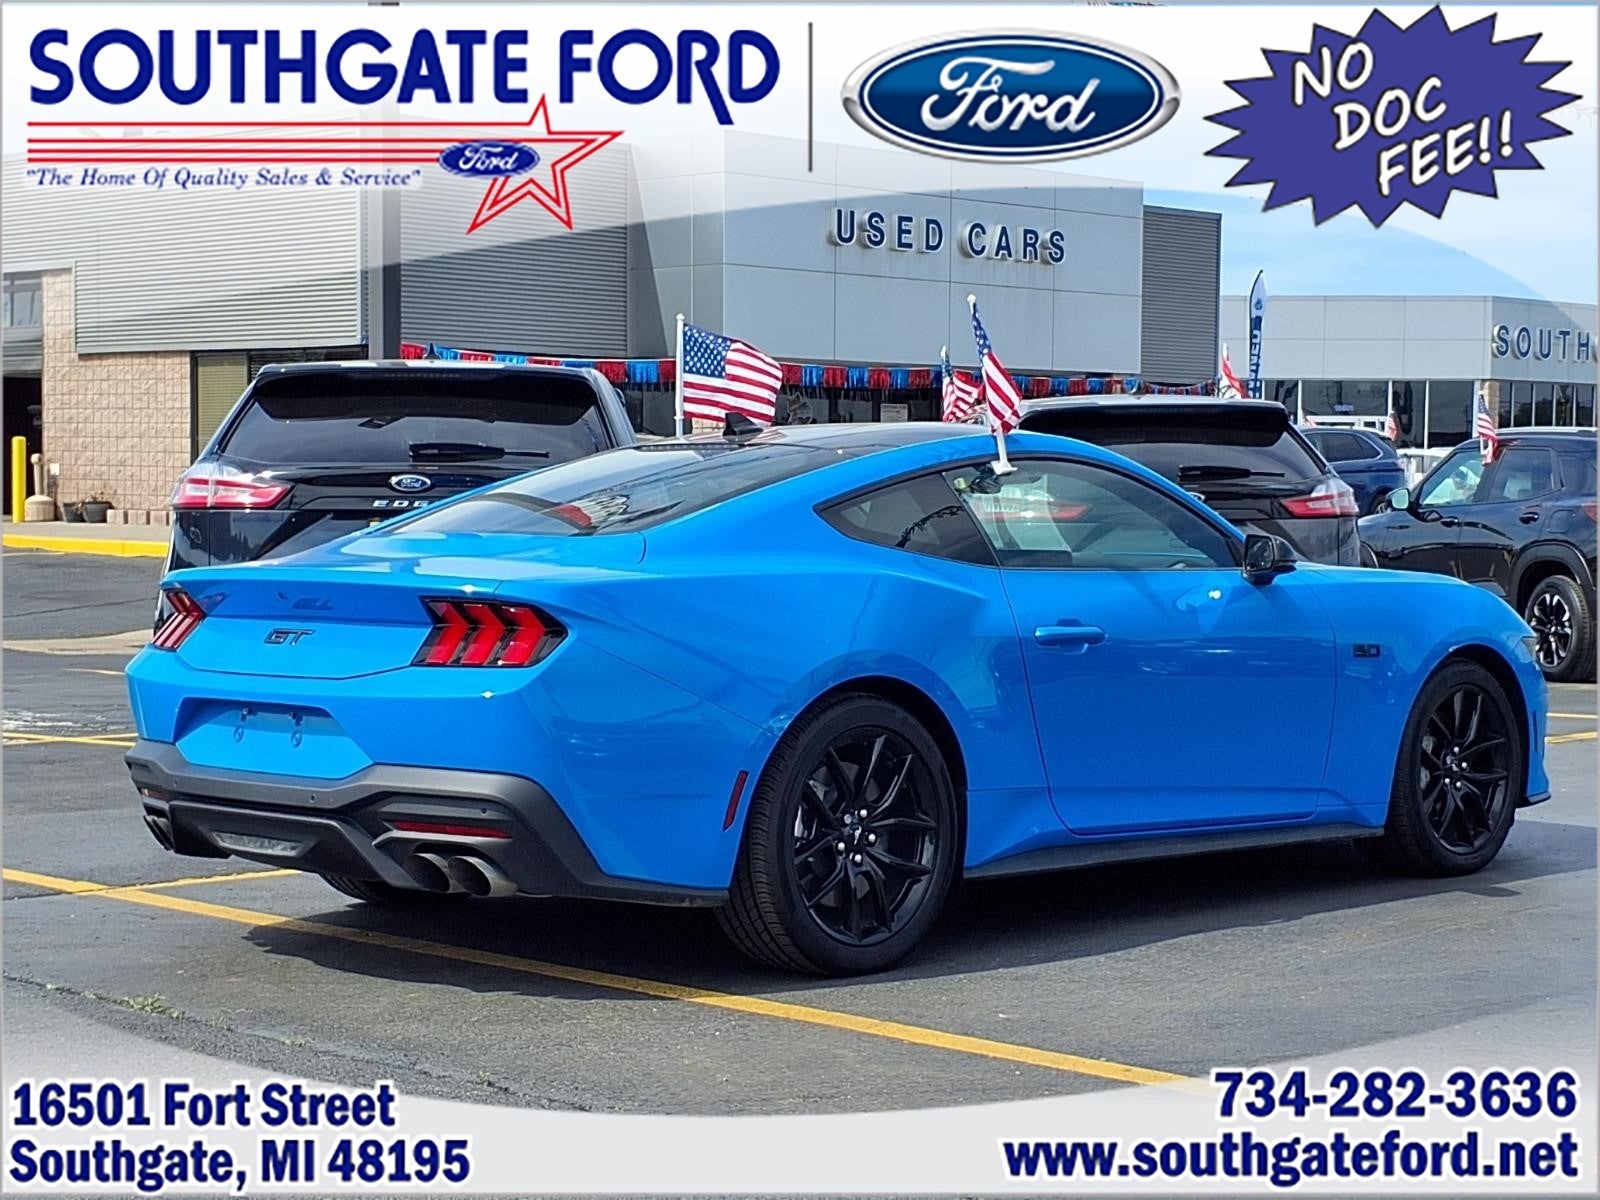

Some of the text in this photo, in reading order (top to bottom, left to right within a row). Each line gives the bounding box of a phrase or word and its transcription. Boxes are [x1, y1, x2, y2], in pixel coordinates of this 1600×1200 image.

[834, 207, 1066, 265] USED CARS
[1493, 323, 1597, 362] SOUTH
[373, 500, 430, 508] EDG
[263, 628, 317, 646] GT
